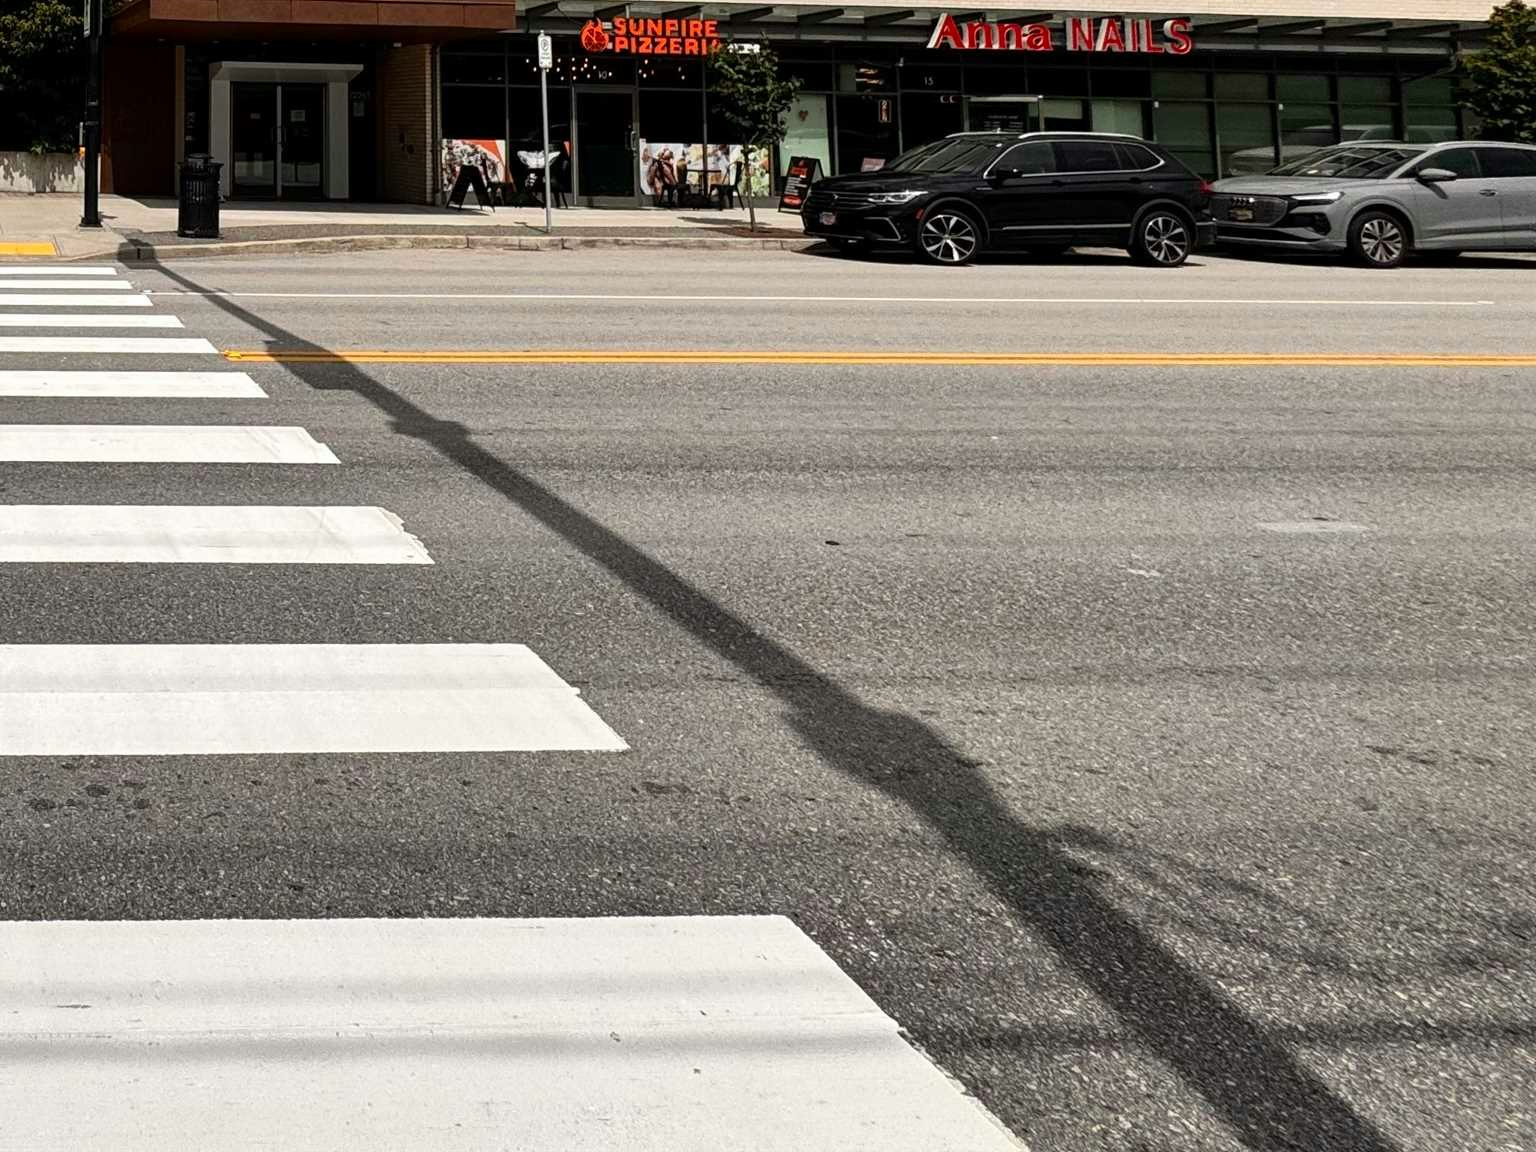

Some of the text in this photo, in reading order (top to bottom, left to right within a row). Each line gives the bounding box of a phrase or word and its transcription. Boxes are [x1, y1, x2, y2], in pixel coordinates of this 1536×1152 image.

[615, 18, 718, 38] SUNFIRE
[927, 12, 1193, 55] Anna NAILS
